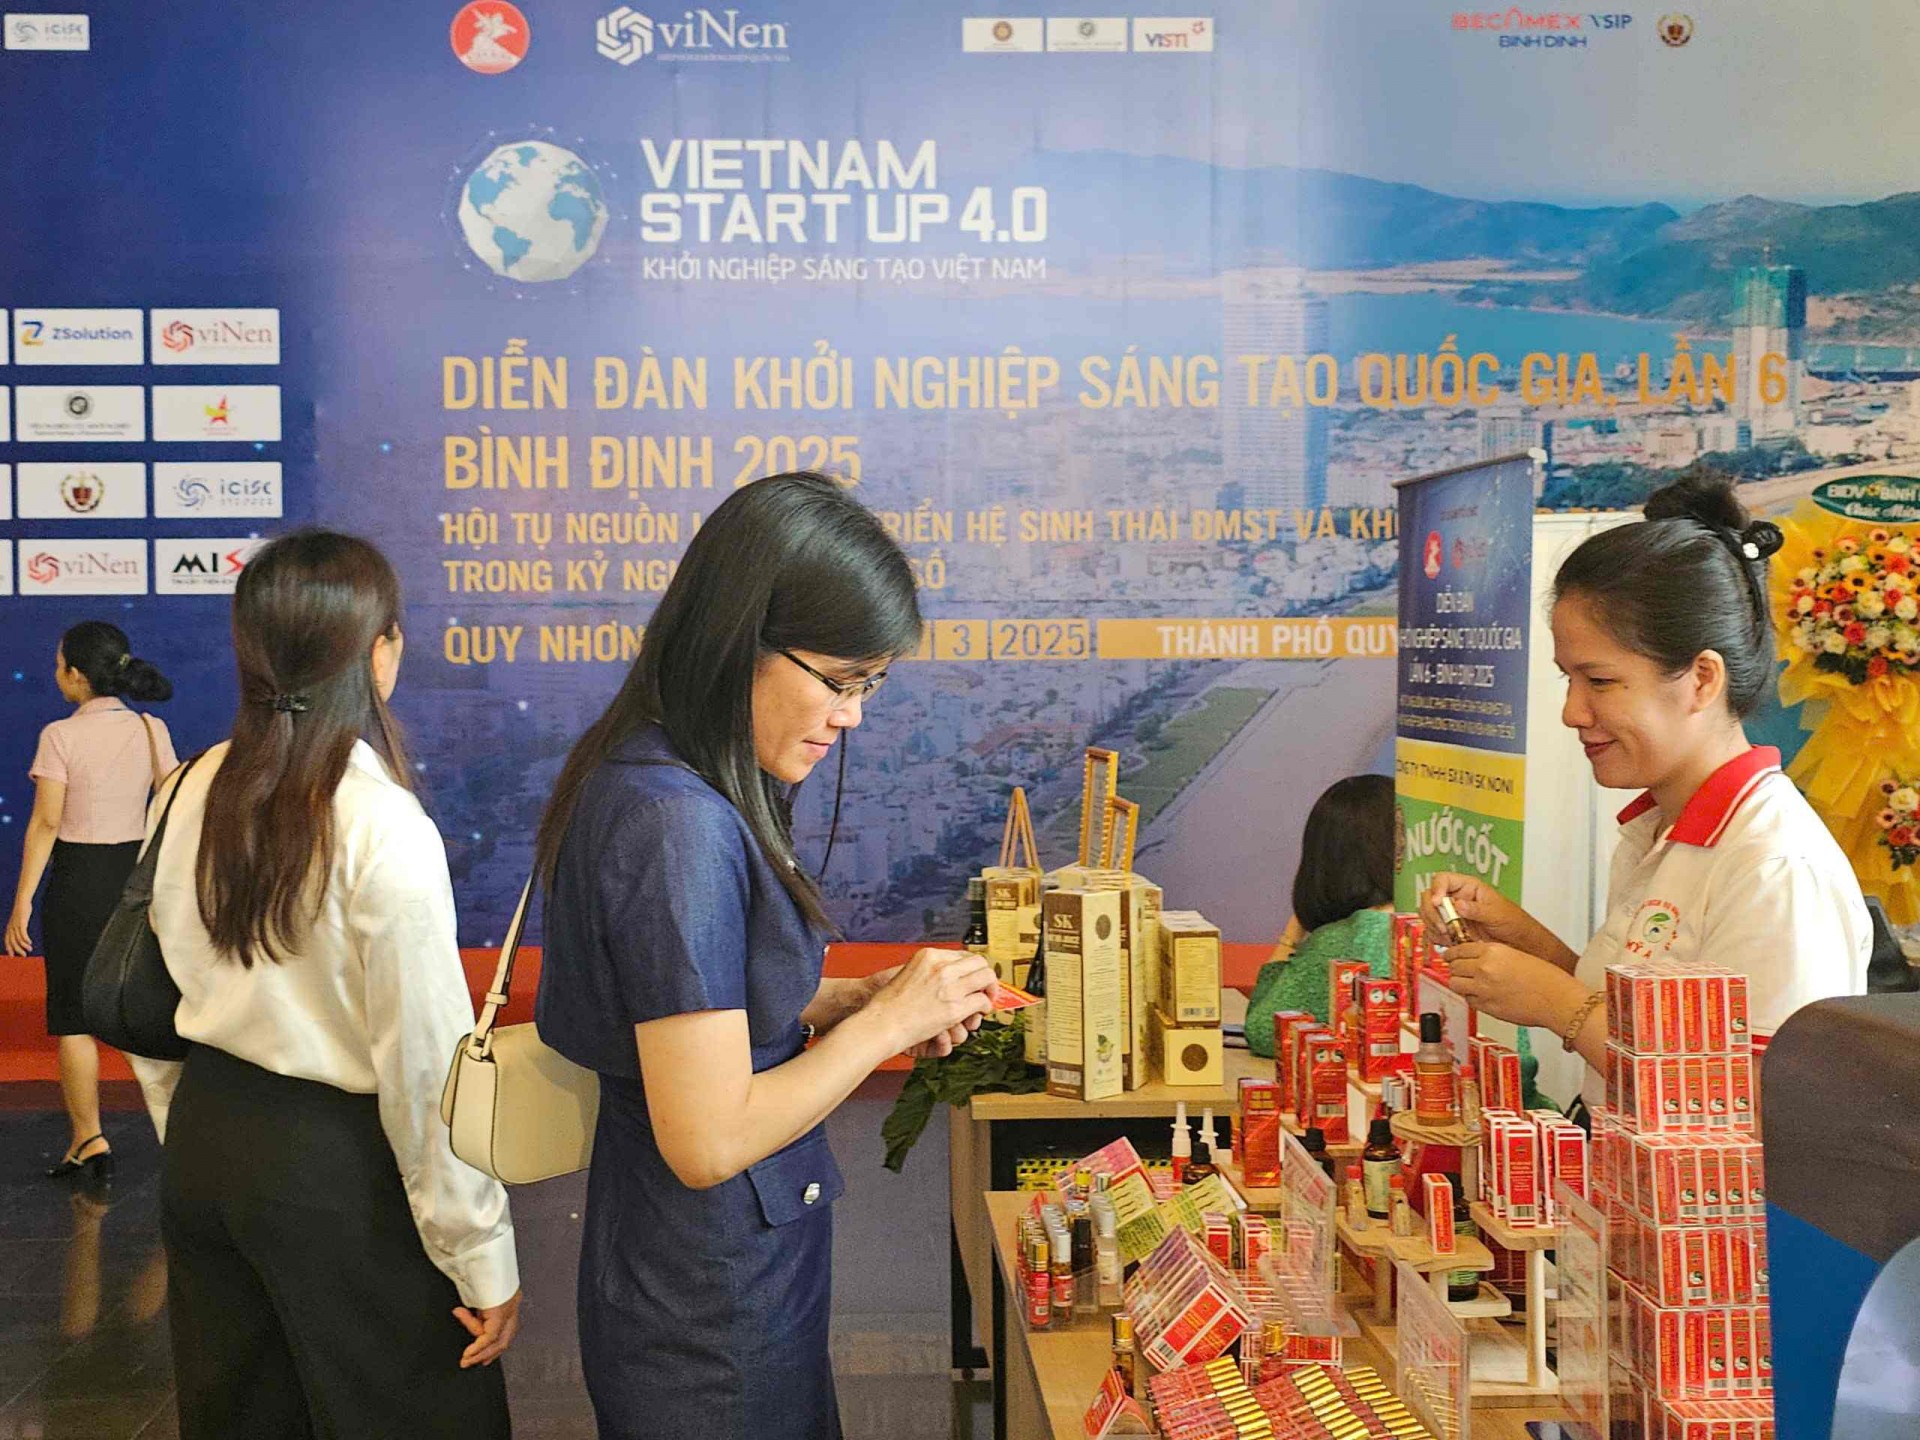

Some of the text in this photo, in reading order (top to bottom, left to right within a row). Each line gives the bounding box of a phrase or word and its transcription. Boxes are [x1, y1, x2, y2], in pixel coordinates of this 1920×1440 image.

[656, 9, 788, 49] viNen
[640, 139, 936, 190] VIETNAM
[640, 185, 1048, 243] START UP 4.0
[642, 250, 1047, 286] KHỞI NGHIỆP SÁNG TẠO VIỆT NAM
[52, 326, 133, 341] ZSolution
[199, 320, 273, 344] viNen
[442, 337, 568, 410] DIỄN
[594, 345, 708, 410] ĐÀN
[734, 338, 853, 410] KHỞI
[874, 345, 1061, 419] NGHIỆP
[1079, 344, 1219, 409] SÁNG
[1238, 354, 1340, 419] TẠO
[1358, 334, 1499, 409] QUỐC
[1637, 332, 1736, 405] LẦN
[1759, 352, 1788, 405] 6
[444, 425, 862, 500] BÌNH ĐỊNH 2025
[443, 506, 499, 550] HỘI
[511, 511, 552, 550] TỤ
[566, 501, 680, 544] NGUỒN
[872, 497, 953, 543] RIỂN
[966, 504, 1006, 547] HỆ
[1018, 509, 1094, 541] SINH
[1107, 503, 1178, 541] THÁI
[1294, 502, 1337, 540] VÀ
[1350, 508, 1398, 540] KH
[64, 552, 138, 575] viNen
[172, 546, 245, 576] MIS
[442, 559, 553, 592] TRONG
[566, 550, 609, 591] KỶ
[443, 624, 523, 665] QUY
[952, 624, 970, 657] 3
[1000, 622, 1086, 656] 2025
[1157, 619, 1259, 655] THÀNH
[1271, 615, 1333, 655] PHỐ
[1406, 805, 1464, 862] NƯỚC
[1464, 822, 1510, 886] CỐT
[1053, 913, 1074, 929] SK
